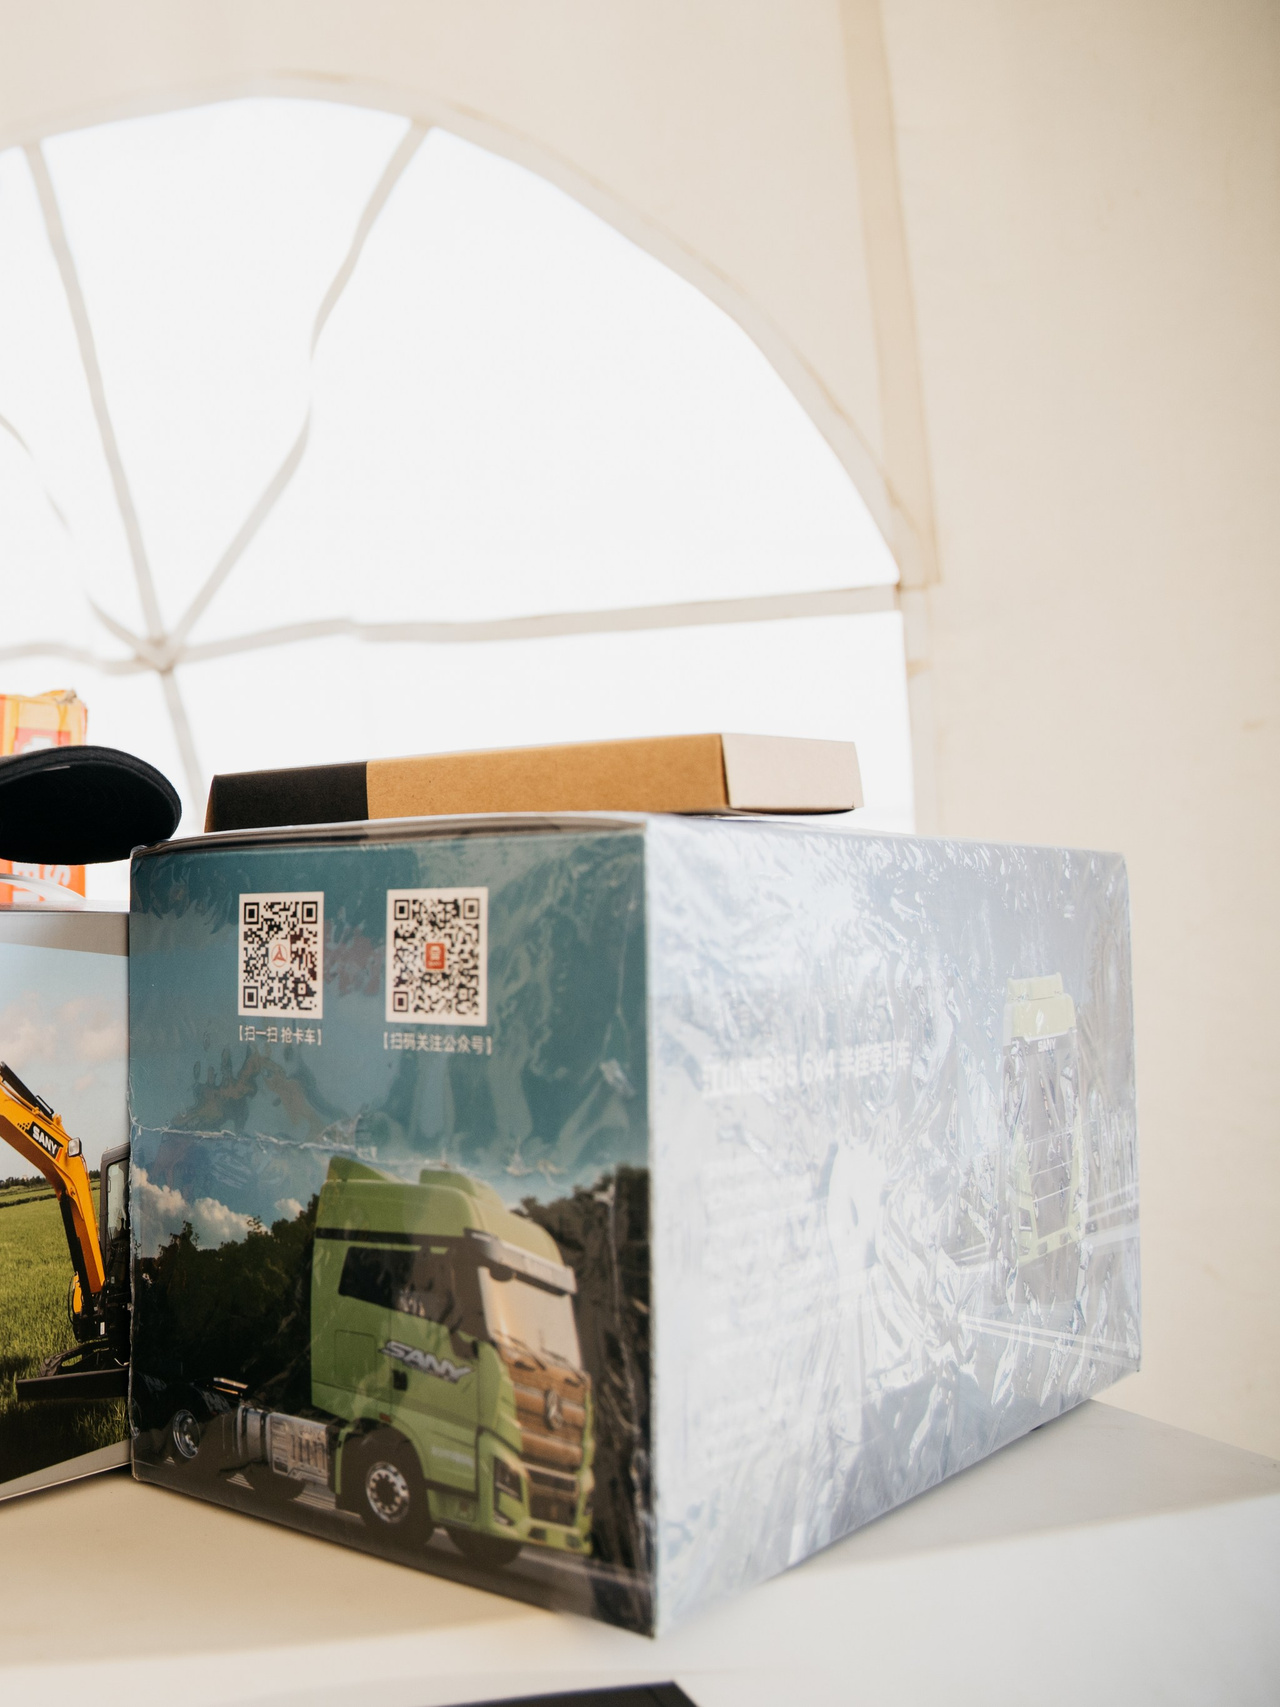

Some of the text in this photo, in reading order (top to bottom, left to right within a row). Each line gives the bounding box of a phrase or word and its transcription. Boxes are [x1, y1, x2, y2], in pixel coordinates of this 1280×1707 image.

[1037, 1037, 1057, 1053] SANY
[32, 1125, 57, 1155] SANY
[381, 1339, 473, 1383] SANY
